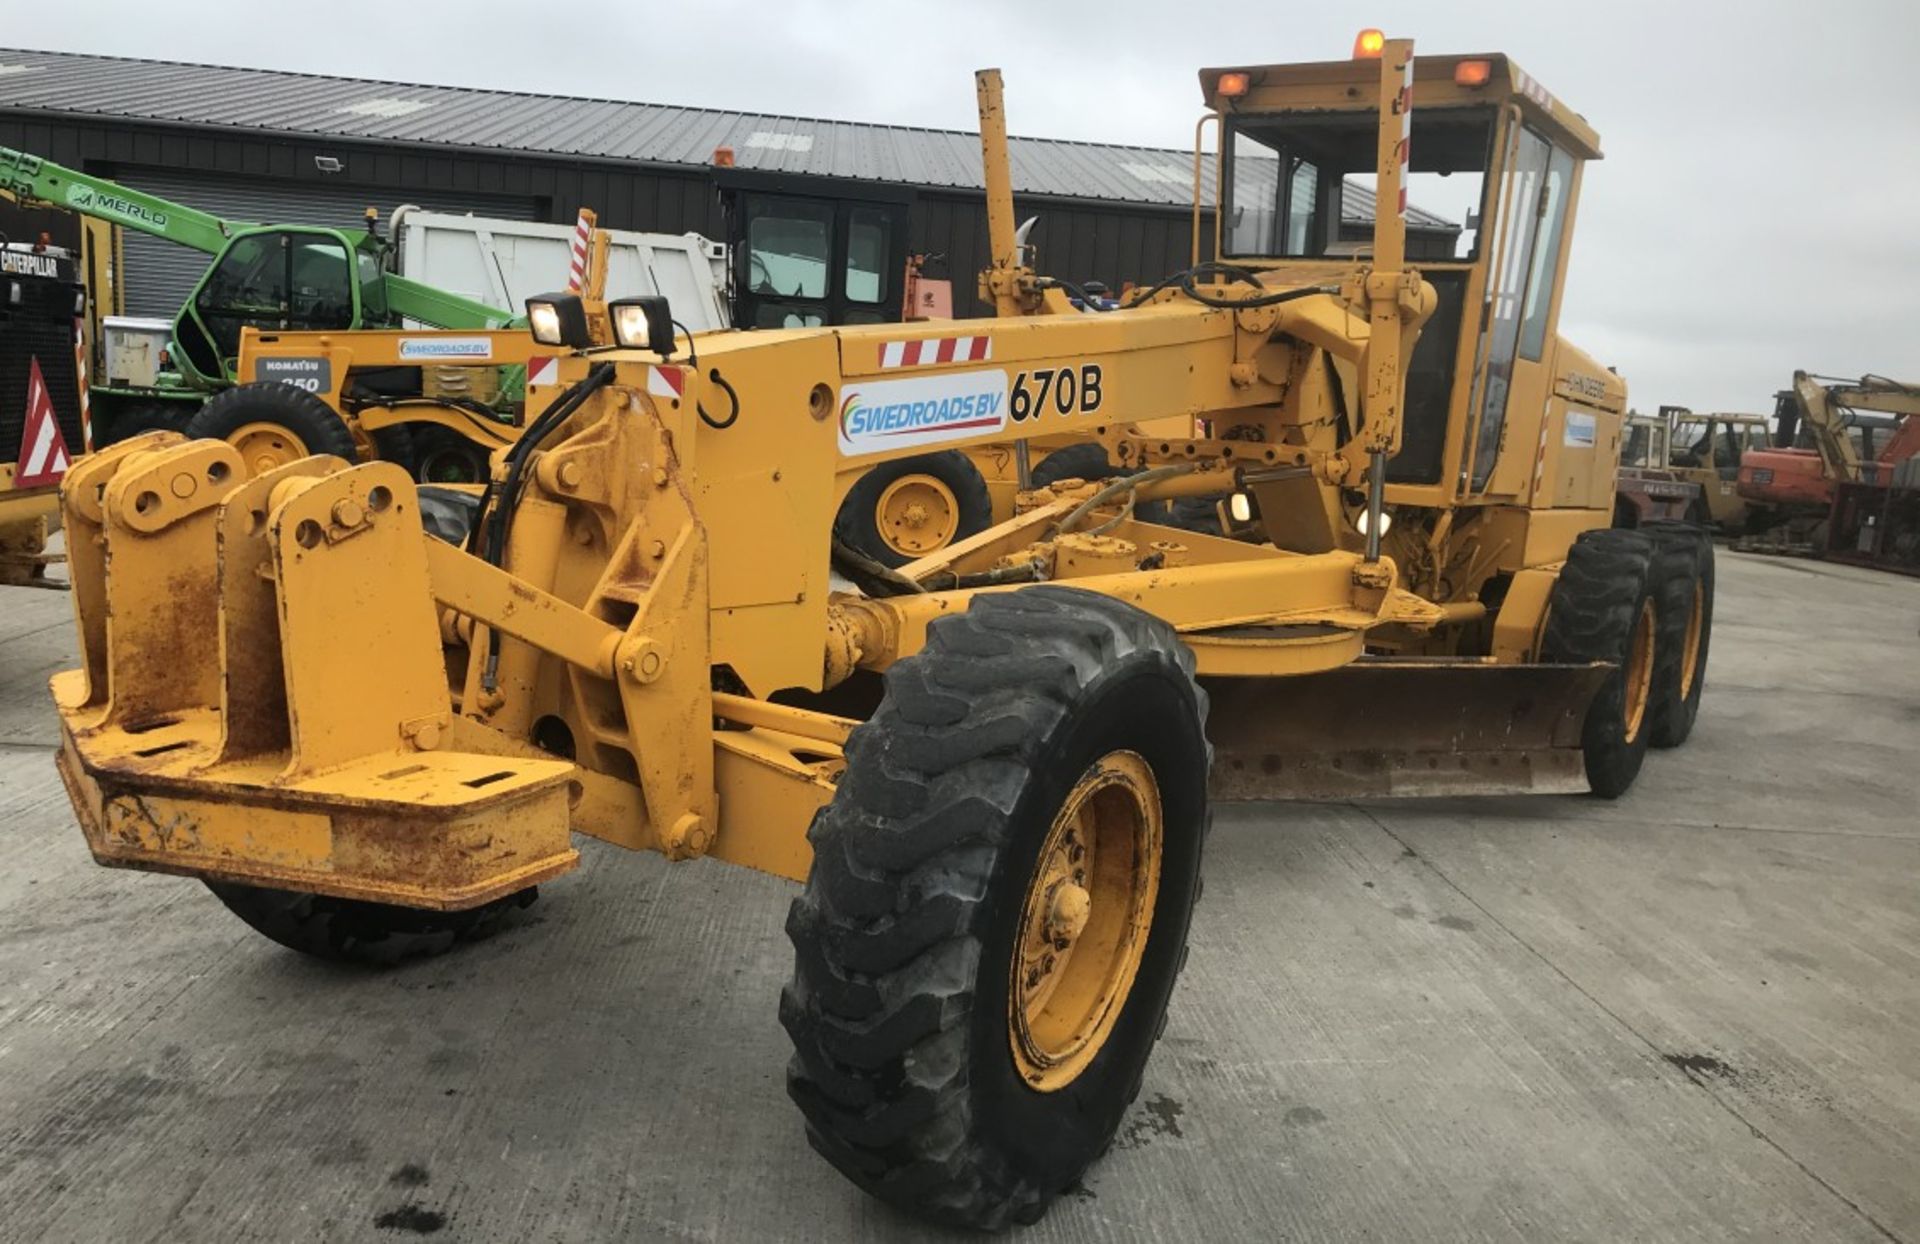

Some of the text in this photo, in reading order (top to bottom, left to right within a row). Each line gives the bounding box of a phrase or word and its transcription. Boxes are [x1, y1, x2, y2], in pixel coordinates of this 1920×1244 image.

[97, 195, 167, 225] MERLO
[1, 251, 58, 278] CATERPILLAR
[266, 360, 319, 370] KOMATSU
[1009, 364, 1102, 422] 670B
[850, 395, 974, 434] SWEDROADS
